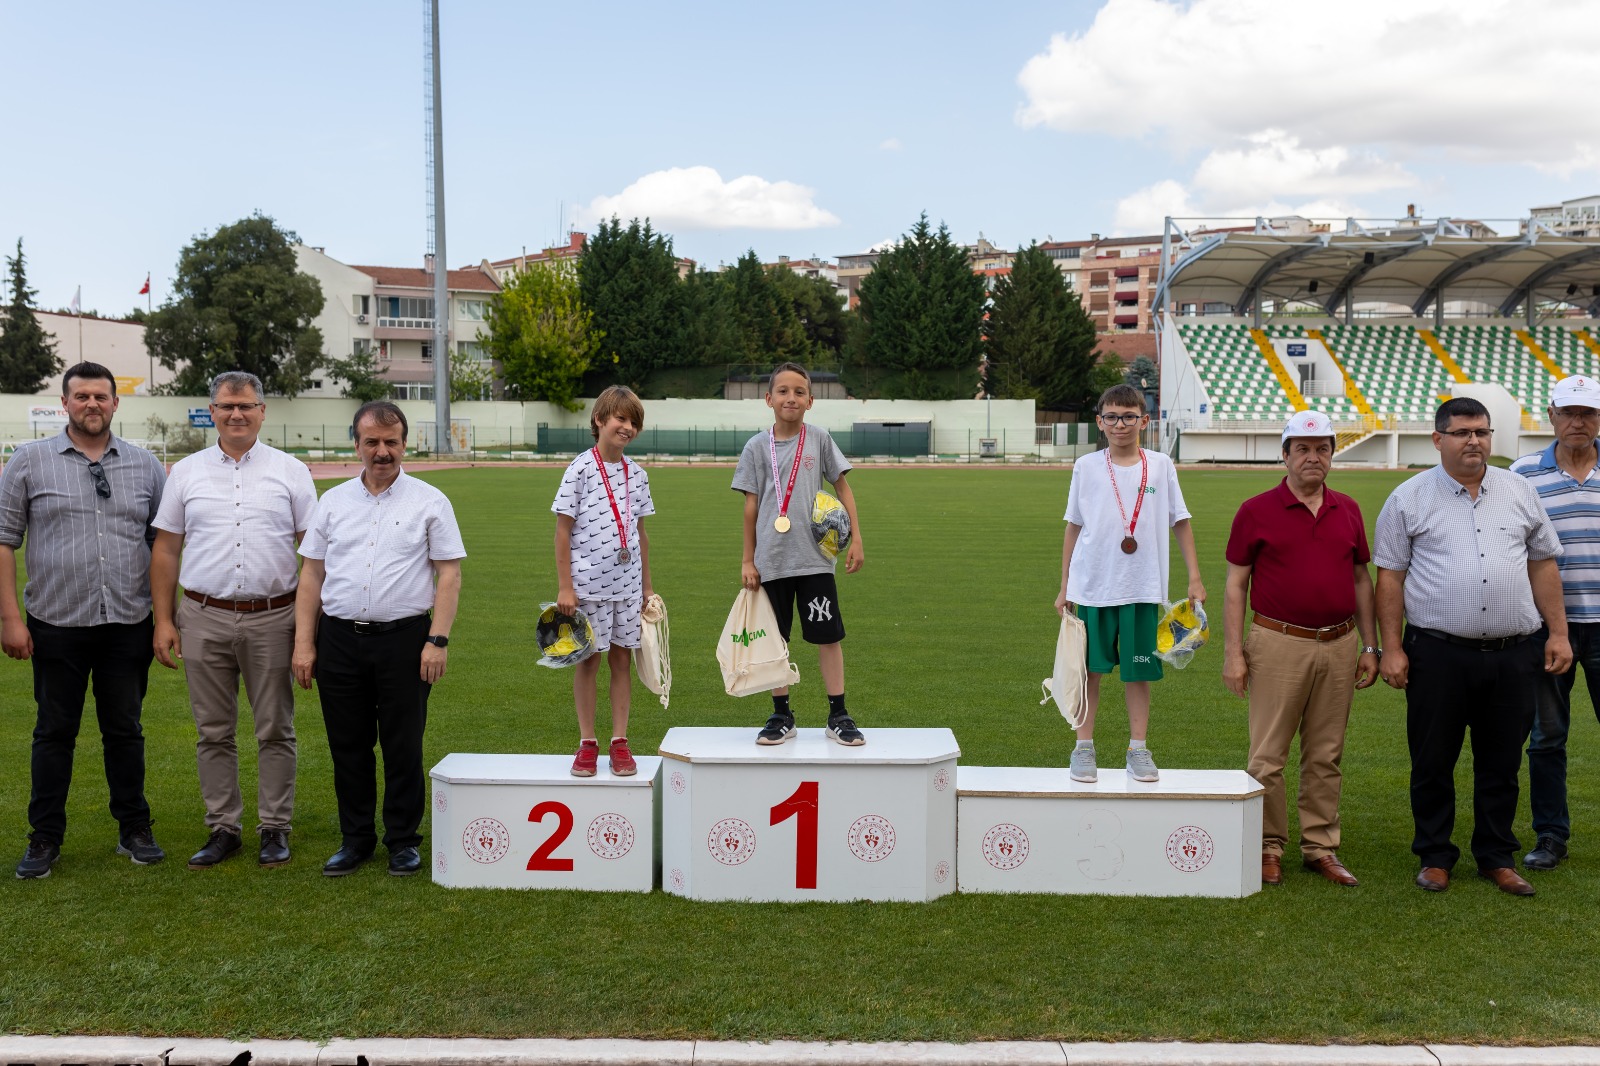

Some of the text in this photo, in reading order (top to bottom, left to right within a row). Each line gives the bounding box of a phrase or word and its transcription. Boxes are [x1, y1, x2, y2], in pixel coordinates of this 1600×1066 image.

[807, 596, 833, 622] NY
[526, 801, 574, 872] 2
[769, 781, 819, 890] 1
